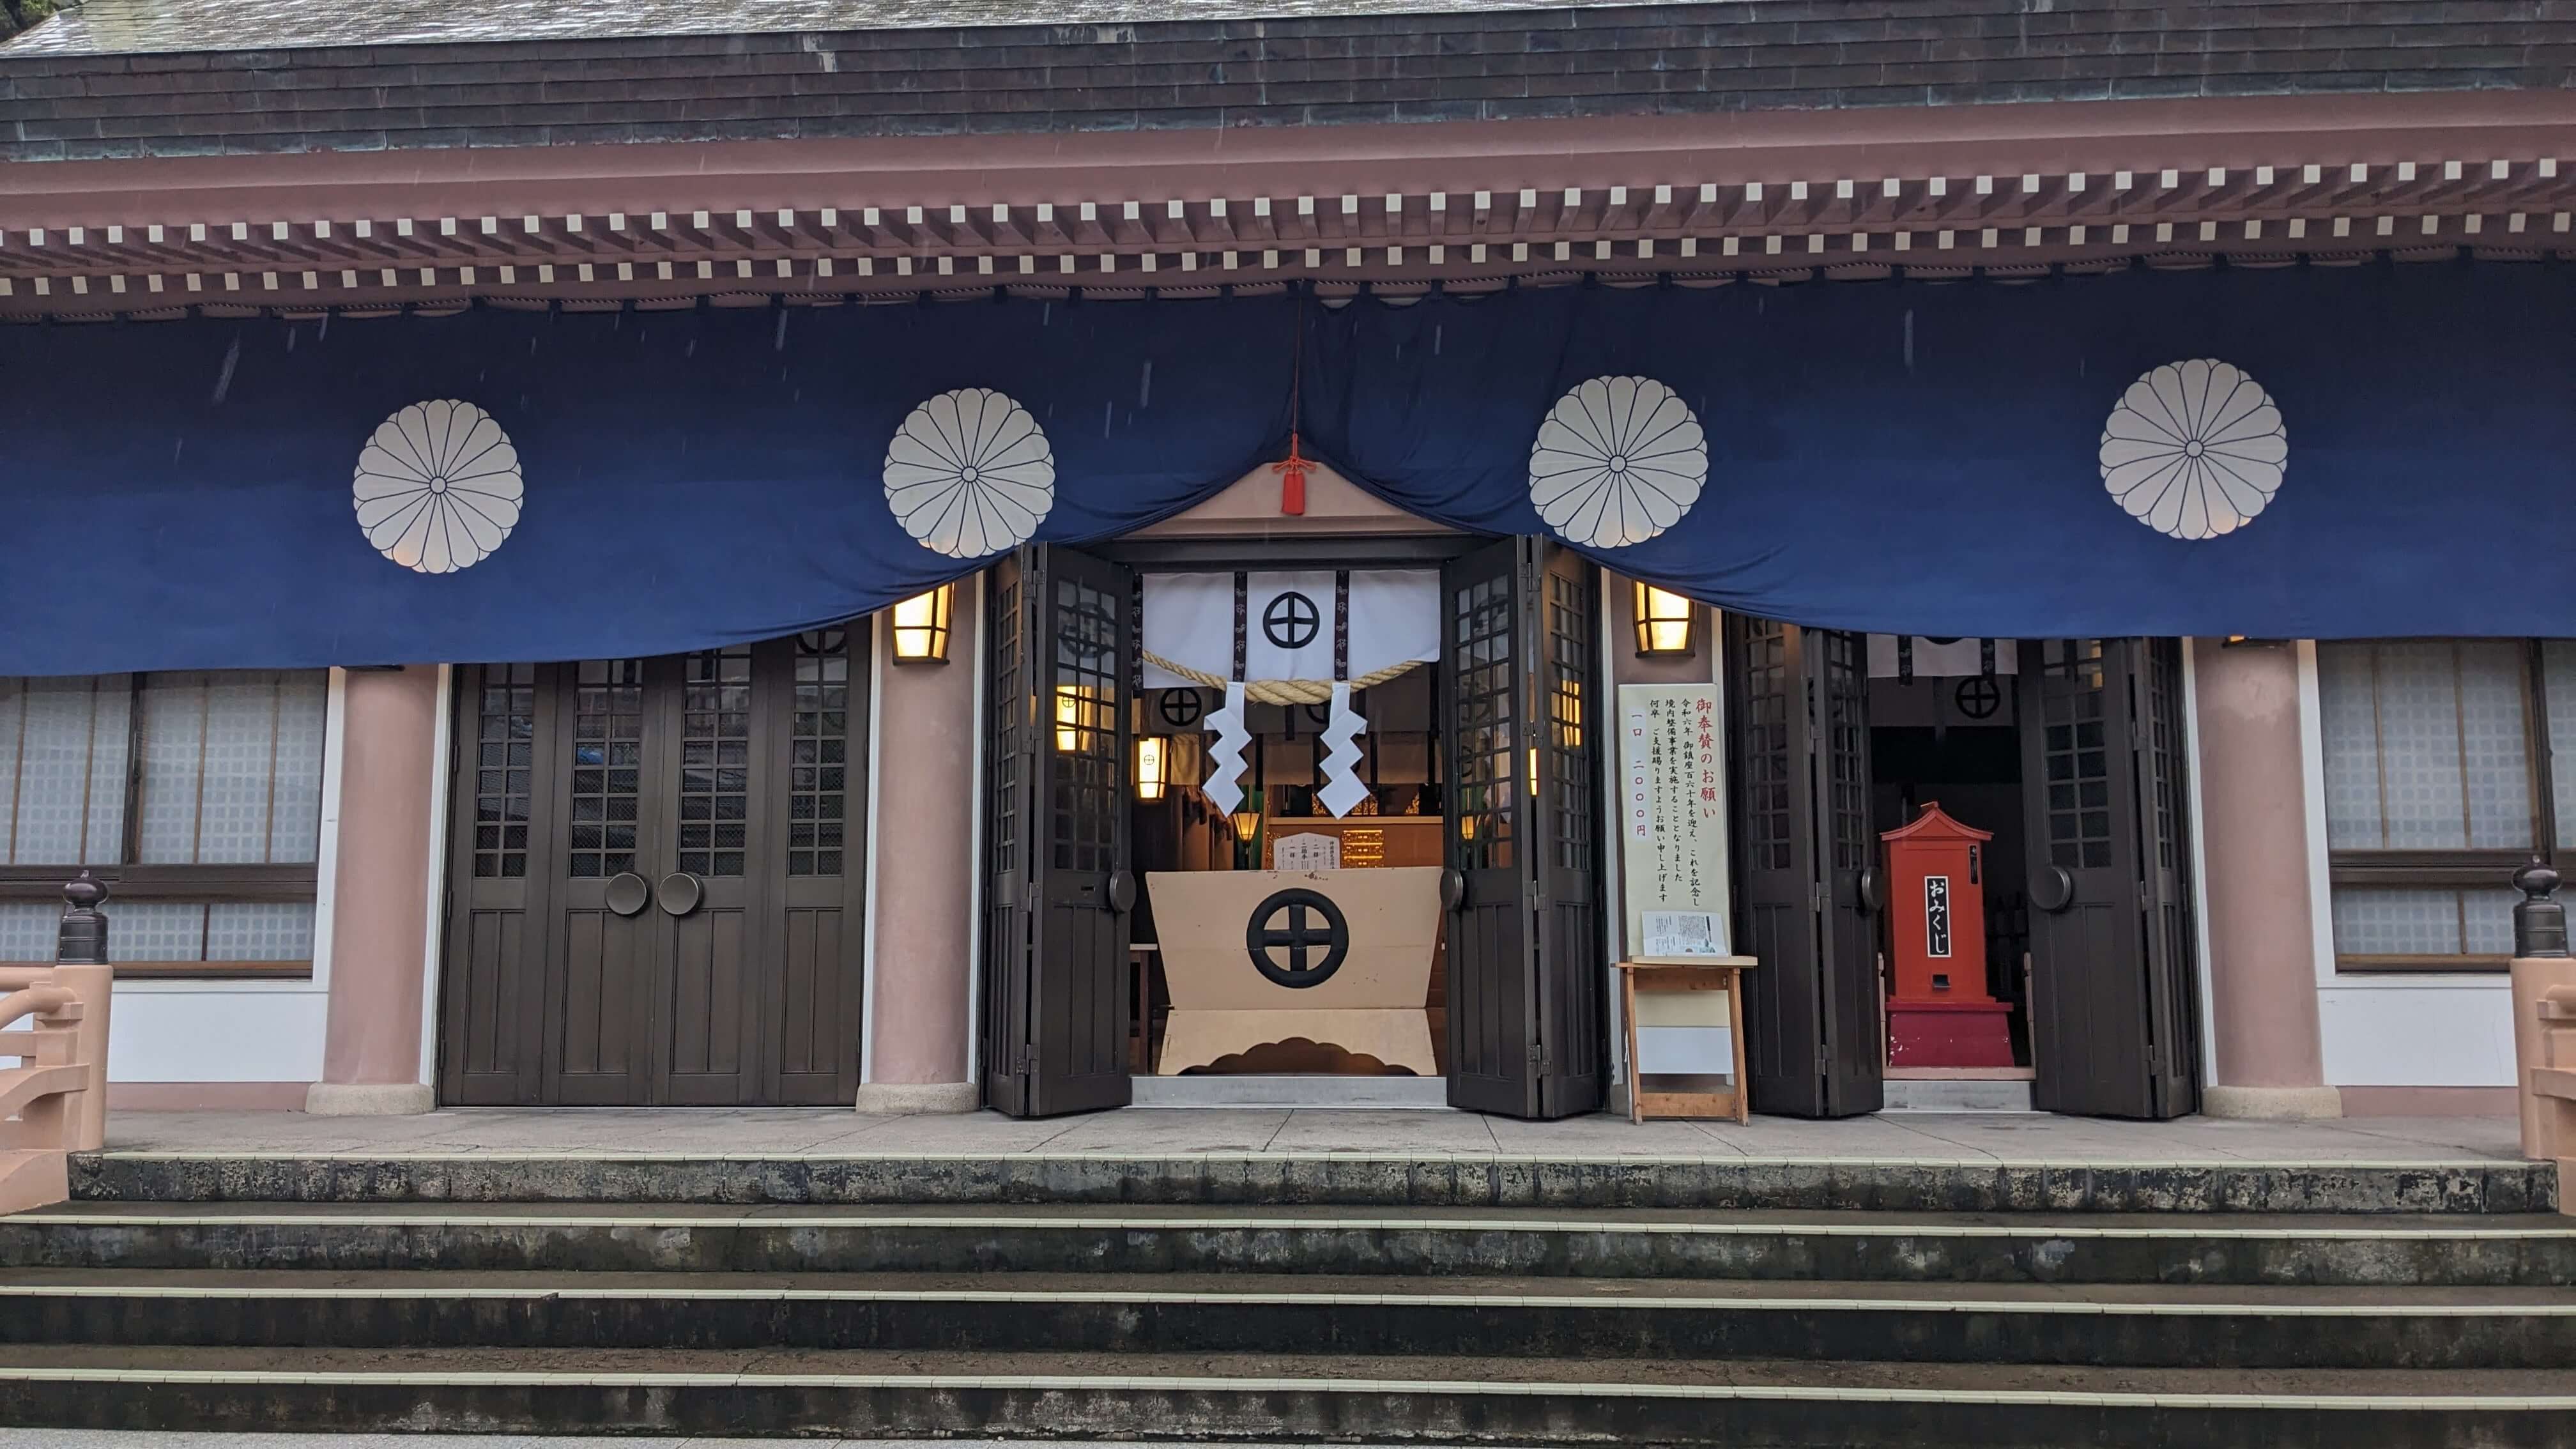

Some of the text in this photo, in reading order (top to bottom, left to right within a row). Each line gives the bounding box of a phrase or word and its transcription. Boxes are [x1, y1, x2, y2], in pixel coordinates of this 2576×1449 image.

[1665, 699, 1682, 882] 境内整備事業を実施することとなりました
[1696, 698, 1716, 818] 御奉賛のお願い
[1929, 880, 1947, 953] おみくじ
